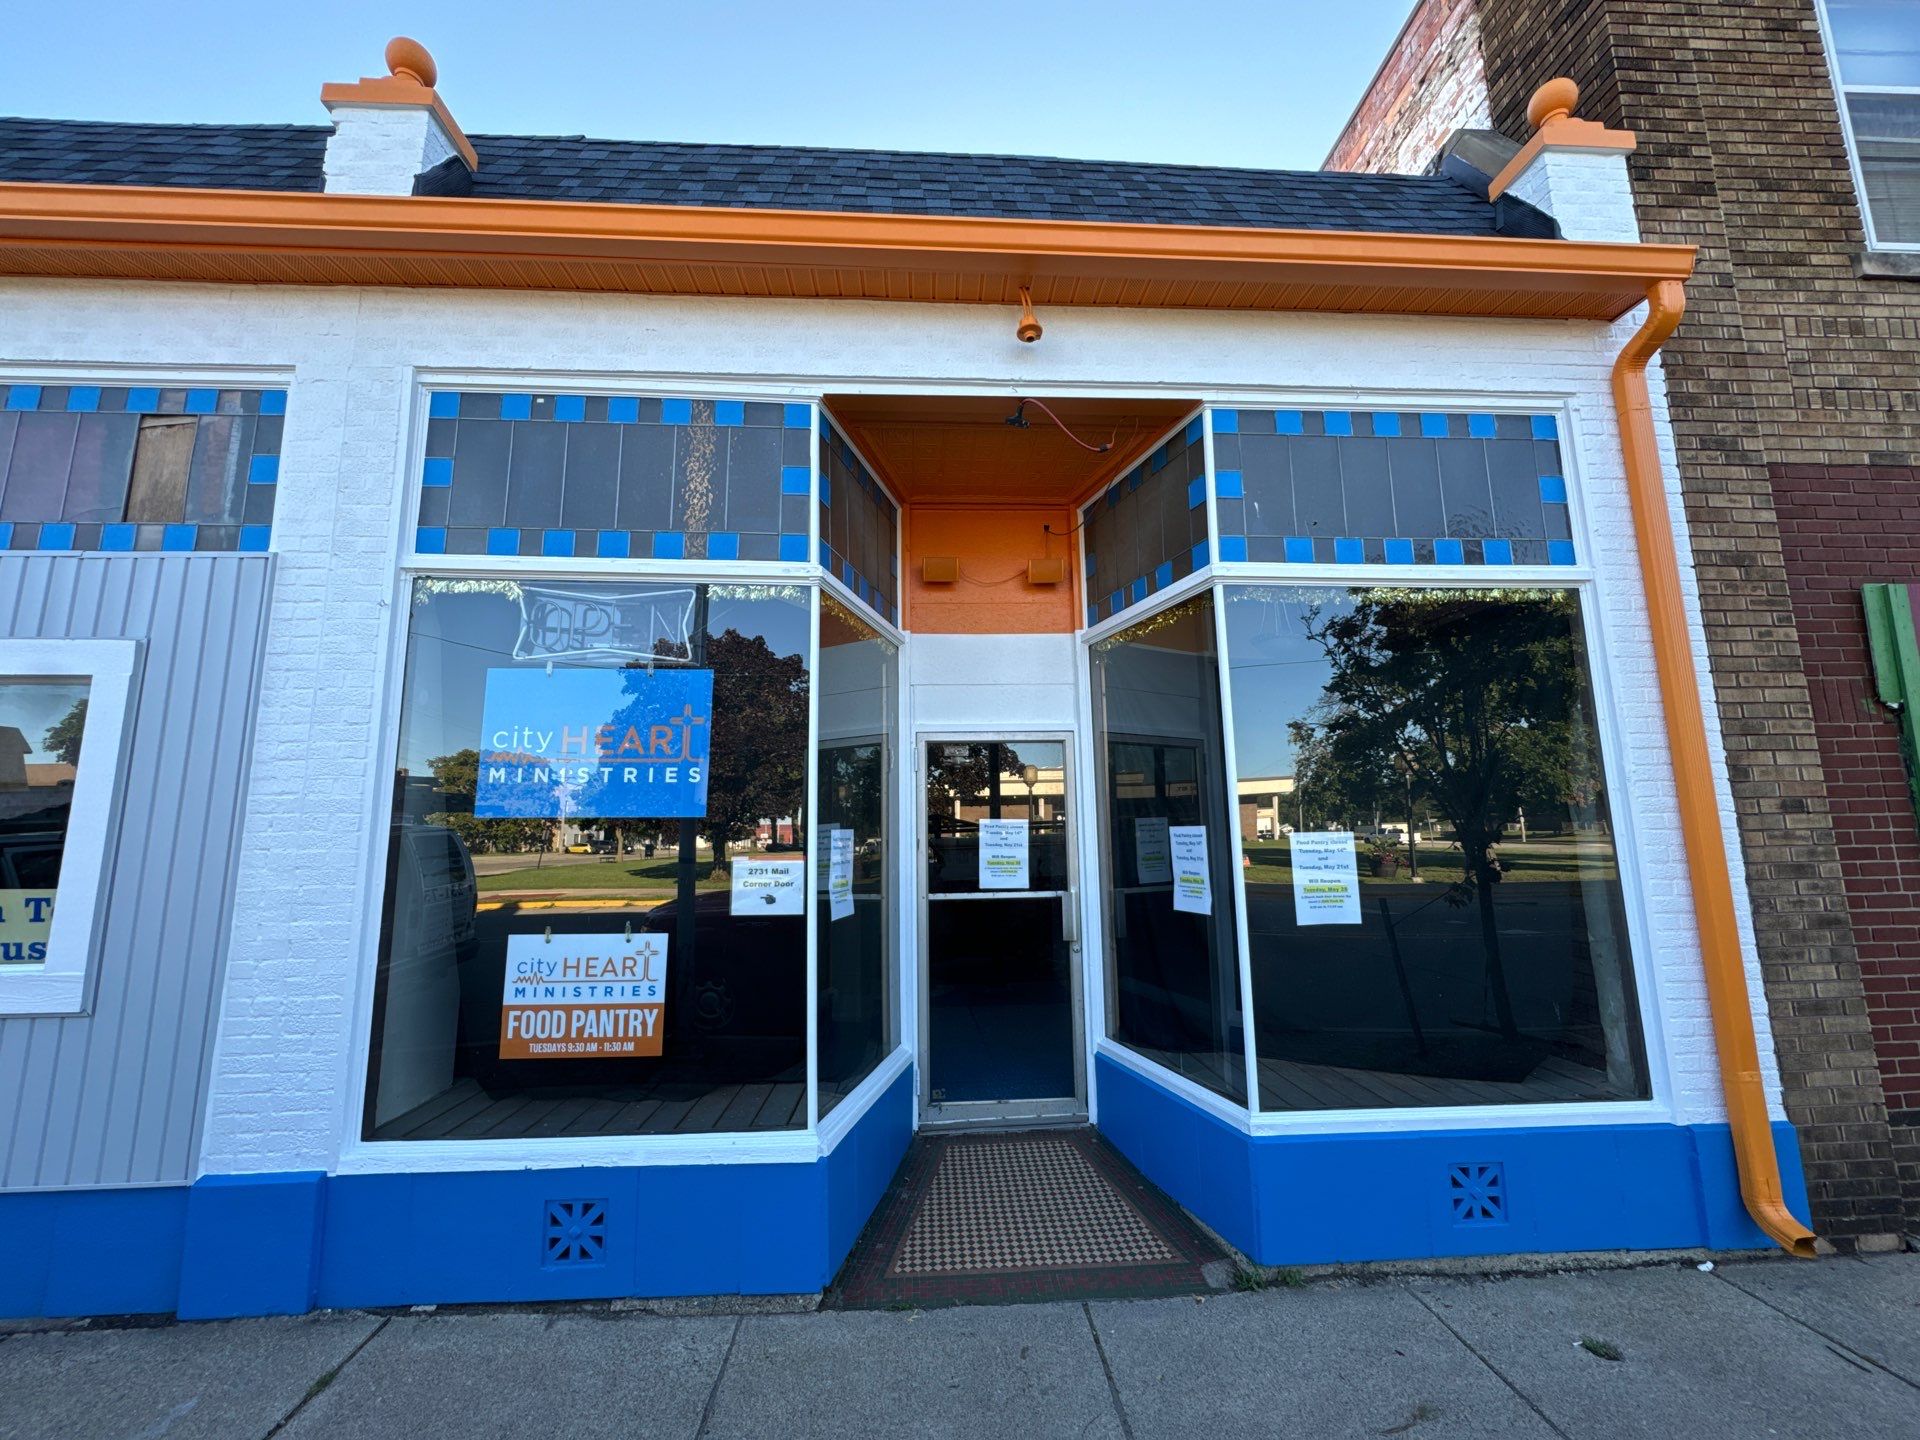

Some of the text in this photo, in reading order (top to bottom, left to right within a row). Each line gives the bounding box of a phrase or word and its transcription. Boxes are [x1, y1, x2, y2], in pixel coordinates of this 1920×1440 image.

[529, 600, 684, 653] OPEN
[492, 724, 554, 753] city
[488, 767, 702, 784] MINISTRIES
[24, 897, 55, 923] T
[517, 957, 558, 977] city
[514, 985, 657, 998] MINISTRIES
[507, 1008, 659, 1040] FOOD PANTRY
[529, 1043, 566, 1053] TUESDAYS
[567, 1042, 585, 1052] 9:30
[586, 1042, 598, 1052] AM
[604, 1042, 622, 1052] 11:30
[622, 1041, 635, 1051] AM
